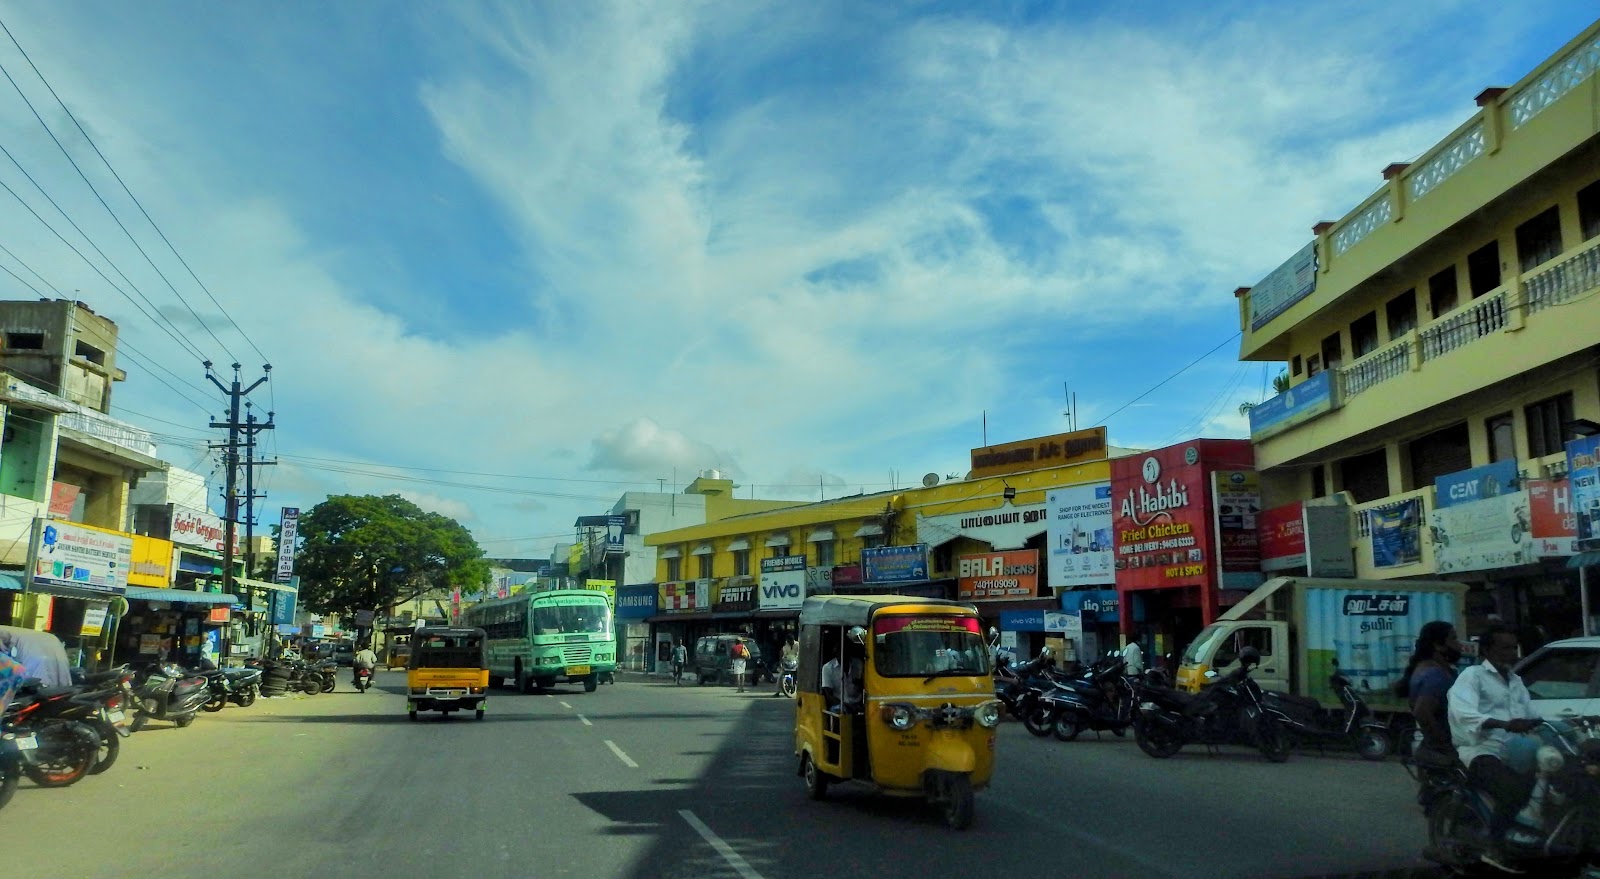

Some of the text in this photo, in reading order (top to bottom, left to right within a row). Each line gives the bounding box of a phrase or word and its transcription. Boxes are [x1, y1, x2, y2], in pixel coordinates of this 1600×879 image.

[1574, 476, 1595, 488] NEW
[1450, 479, 1479, 500] CEAT
[1121, 478, 1189, 526] Al-Habibi
[1080, 509, 1112, 518] ELECTRONICS
[1121, 523, 1190, 542] Fried Chicken
[1134, 541, 1159, 552] DELIVERY
[102, 550, 117, 559] SERVICE
[764, 556, 803, 567] FRIENDS MOBILE
[960, 557, 1035, 578] BALA SIGNS
[1165, 567, 1179, 577] HOT
[1185, 565, 1204, 577] SPICY
[762, 581, 800, 599] vivo
[973, 579, 1018, 589] 7401109090
[618, 595, 653, 607] SAMSUNG
[1347, 595, 1407, 616] ஹட்சன்
[1360, 617, 1393, 634] தயிர்
